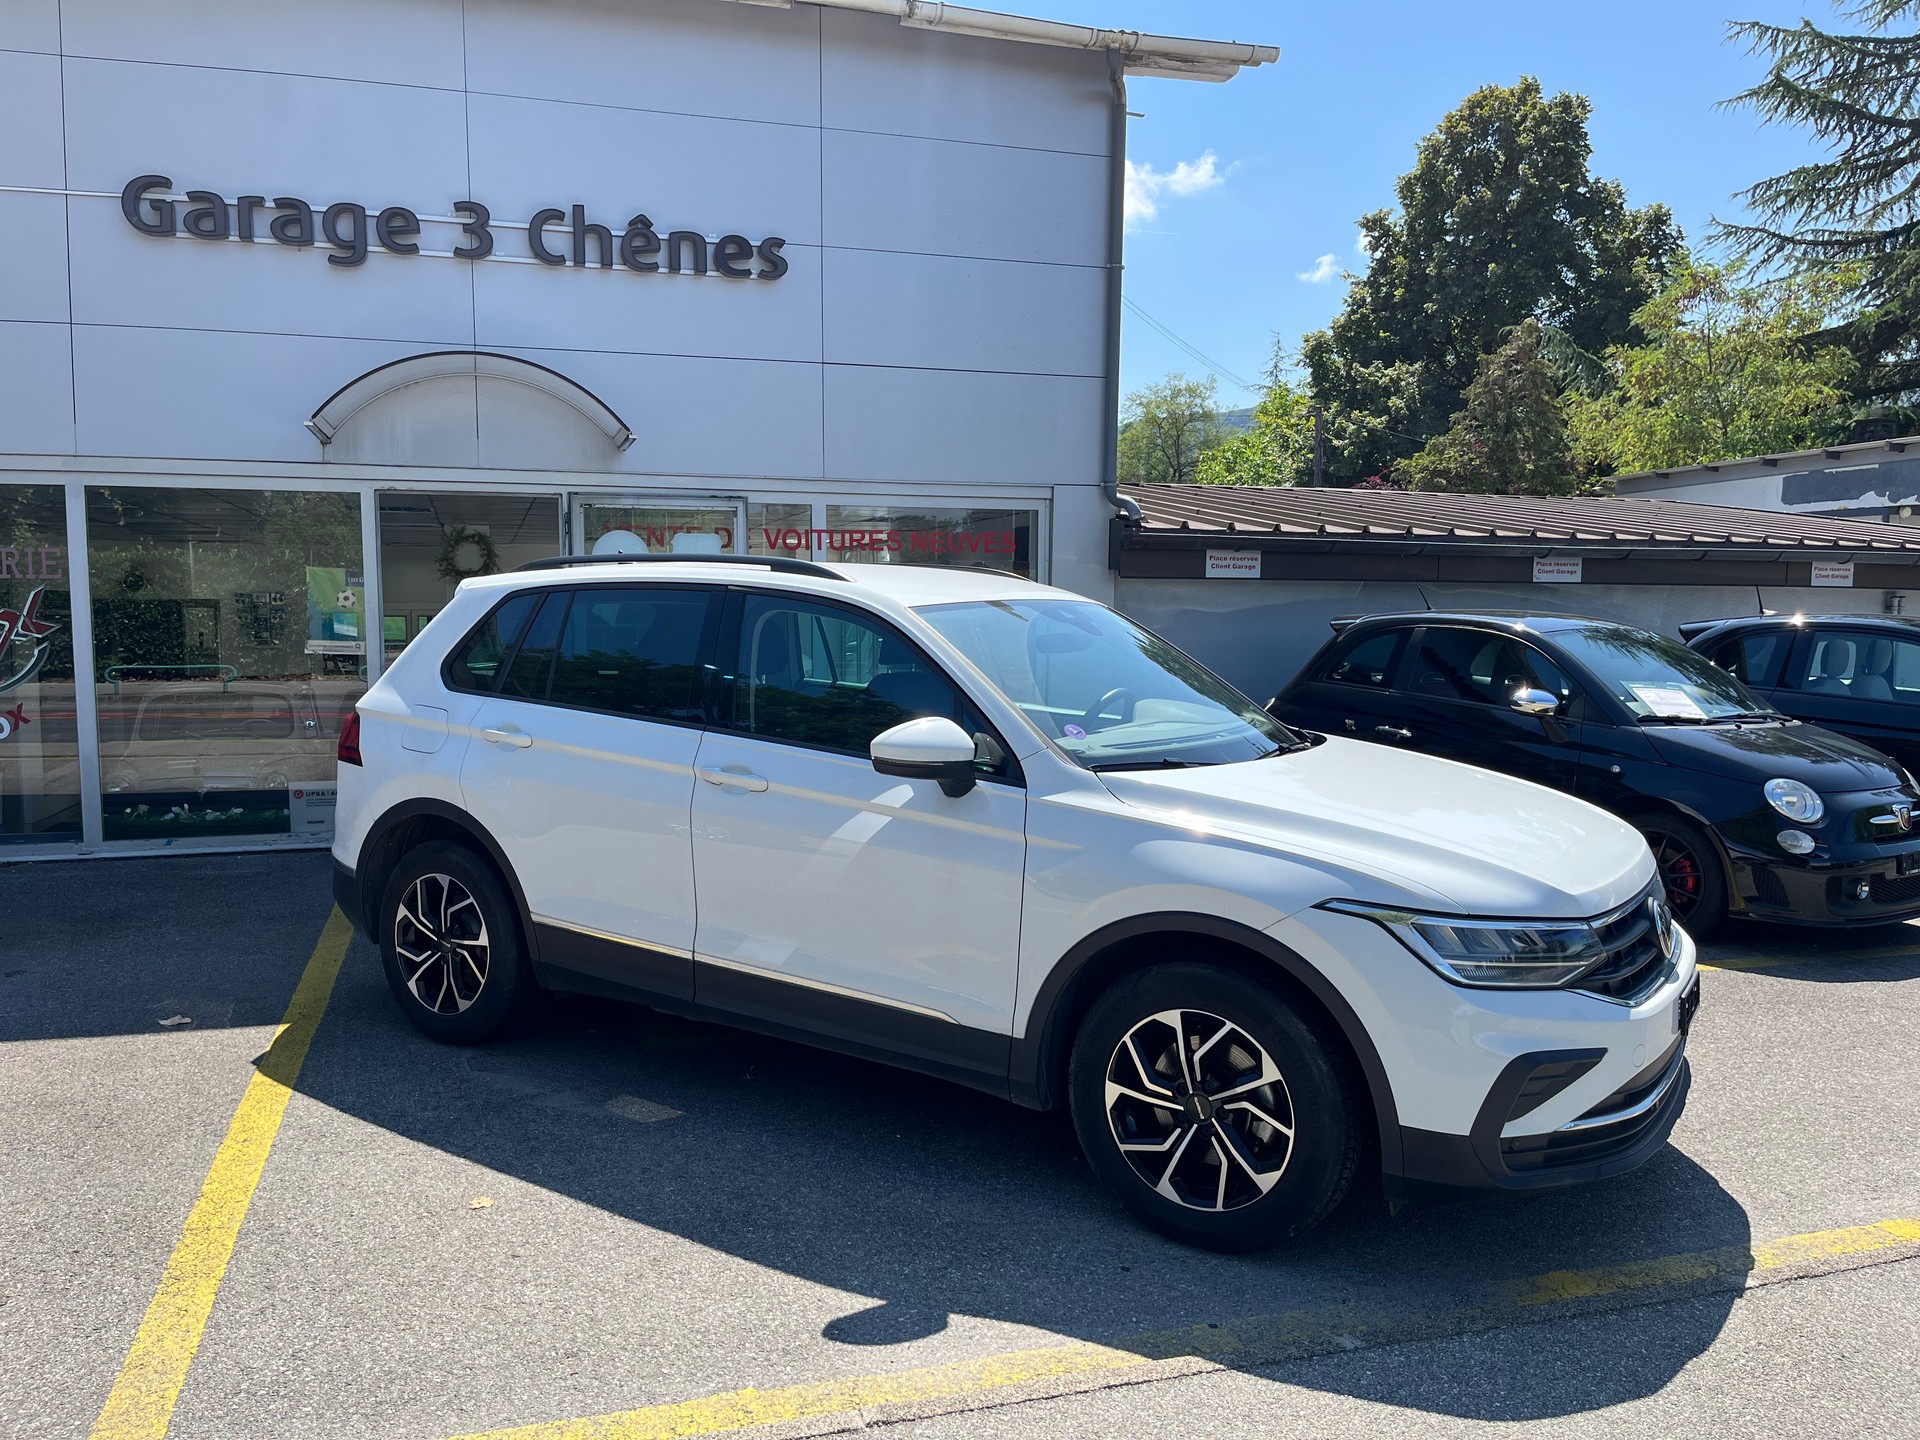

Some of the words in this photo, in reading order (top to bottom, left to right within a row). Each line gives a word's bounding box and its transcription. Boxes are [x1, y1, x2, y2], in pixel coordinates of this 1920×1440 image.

[120, 174, 421, 268] Garage
[452, 200, 494, 260] 3
[528, 204, 789, 281] Chênes
[763, 528, 903, 553] VOITURES
[910, 530, 1016, 555] NEUVES
